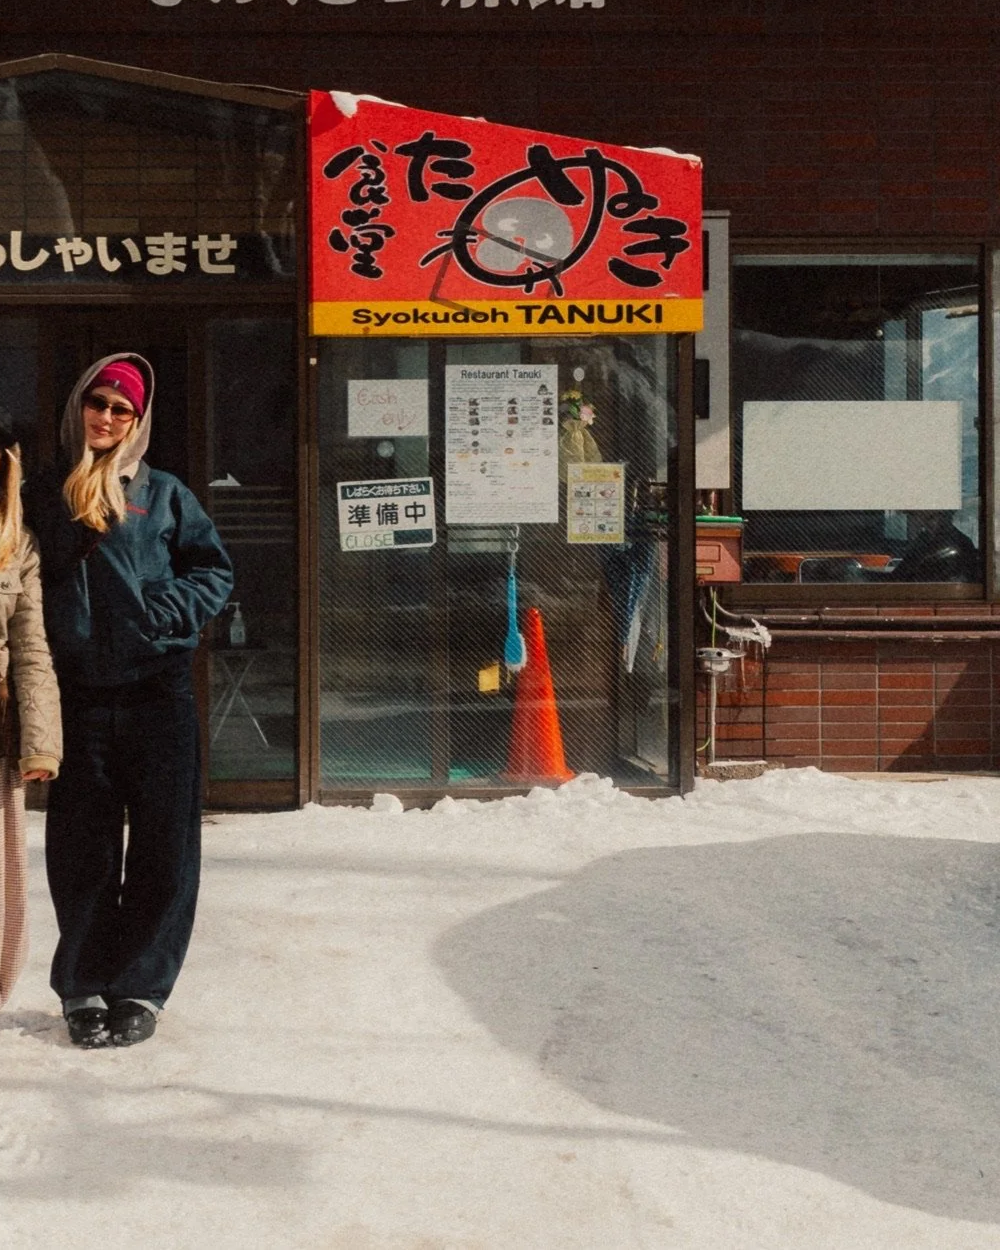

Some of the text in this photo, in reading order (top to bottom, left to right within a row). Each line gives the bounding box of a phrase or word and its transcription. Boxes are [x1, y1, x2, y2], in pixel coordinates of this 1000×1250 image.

[322, 140, 396, 280] 食堂
[352, 304, 663, 327] Syokudoh TANUKI
[460, 369, 542, 379] Restaurant Tanuki
[346, 483, 426, 498] しばらくお待ち下さい
[347, 501, 427, 527] 準備中
[345, 533, 394, 549] CLOSE
